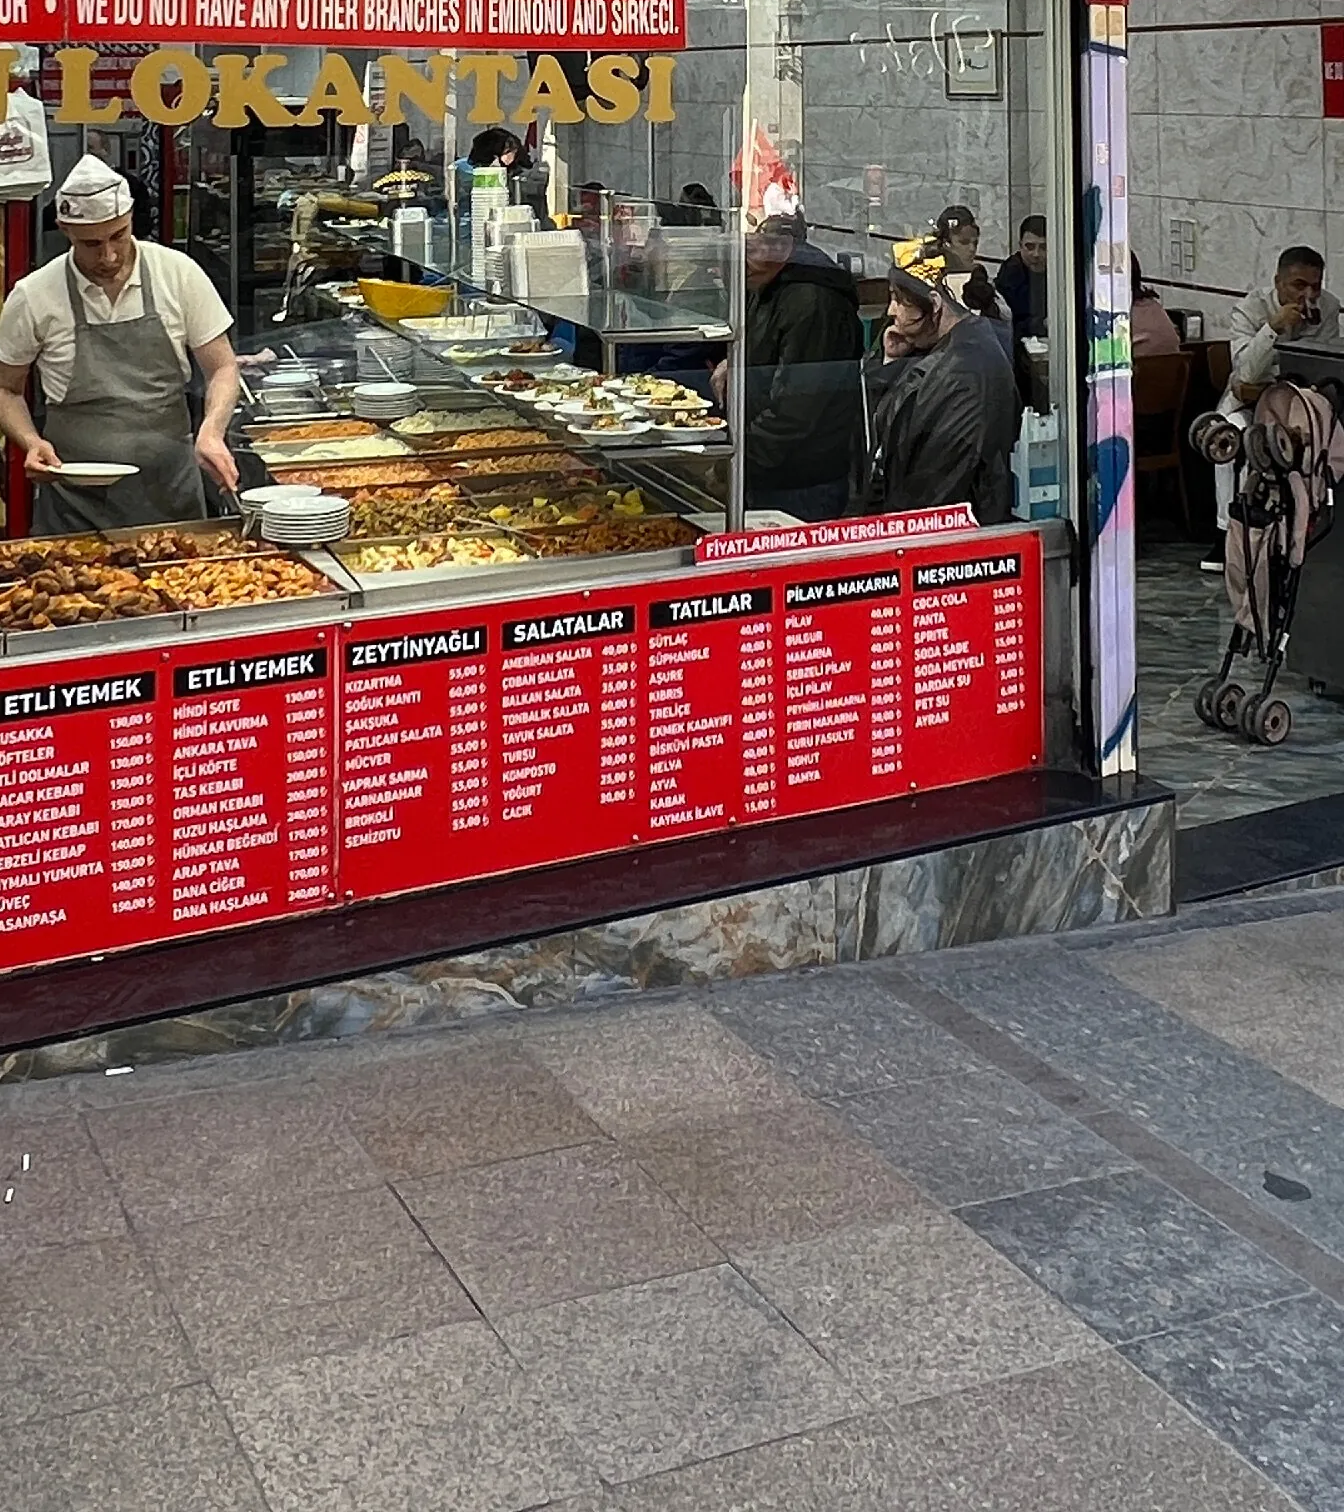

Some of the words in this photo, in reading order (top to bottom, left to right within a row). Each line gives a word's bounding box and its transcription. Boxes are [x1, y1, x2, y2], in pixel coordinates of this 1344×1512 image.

[54, 46, 677, 129] LOKANTASI
[706, 530, 808, 558] FİYATLARIMIZA
[810, 525, 841, 544] TÜM
[842, 519, 905, 541] VERGİLER
[907, 512, 970, 532] DAHİLDİR.
[786, 585, 824, 604] PİLAV
[826, 583, 835, 598] &
[837, 574, 900, 596] MAKARNA
[917, 558, 1017, 586] MEŞRUBATLAR
[668, 592, 753, 621] TATLILAR
[912, 595, 939, 612] COCA
[940, 591, 968, 608] COLA
[513, 611, 624, 644] SALATALAR
[352, 630, 481, 667] ZEYTİNYAĞLI
[188, 661, 236, 690] ETLİ
[241, 653, 315, 684] YEMEK
[4, 685, 56, 717] ETLİ
[61, 678, 141, 709] YEMEK
